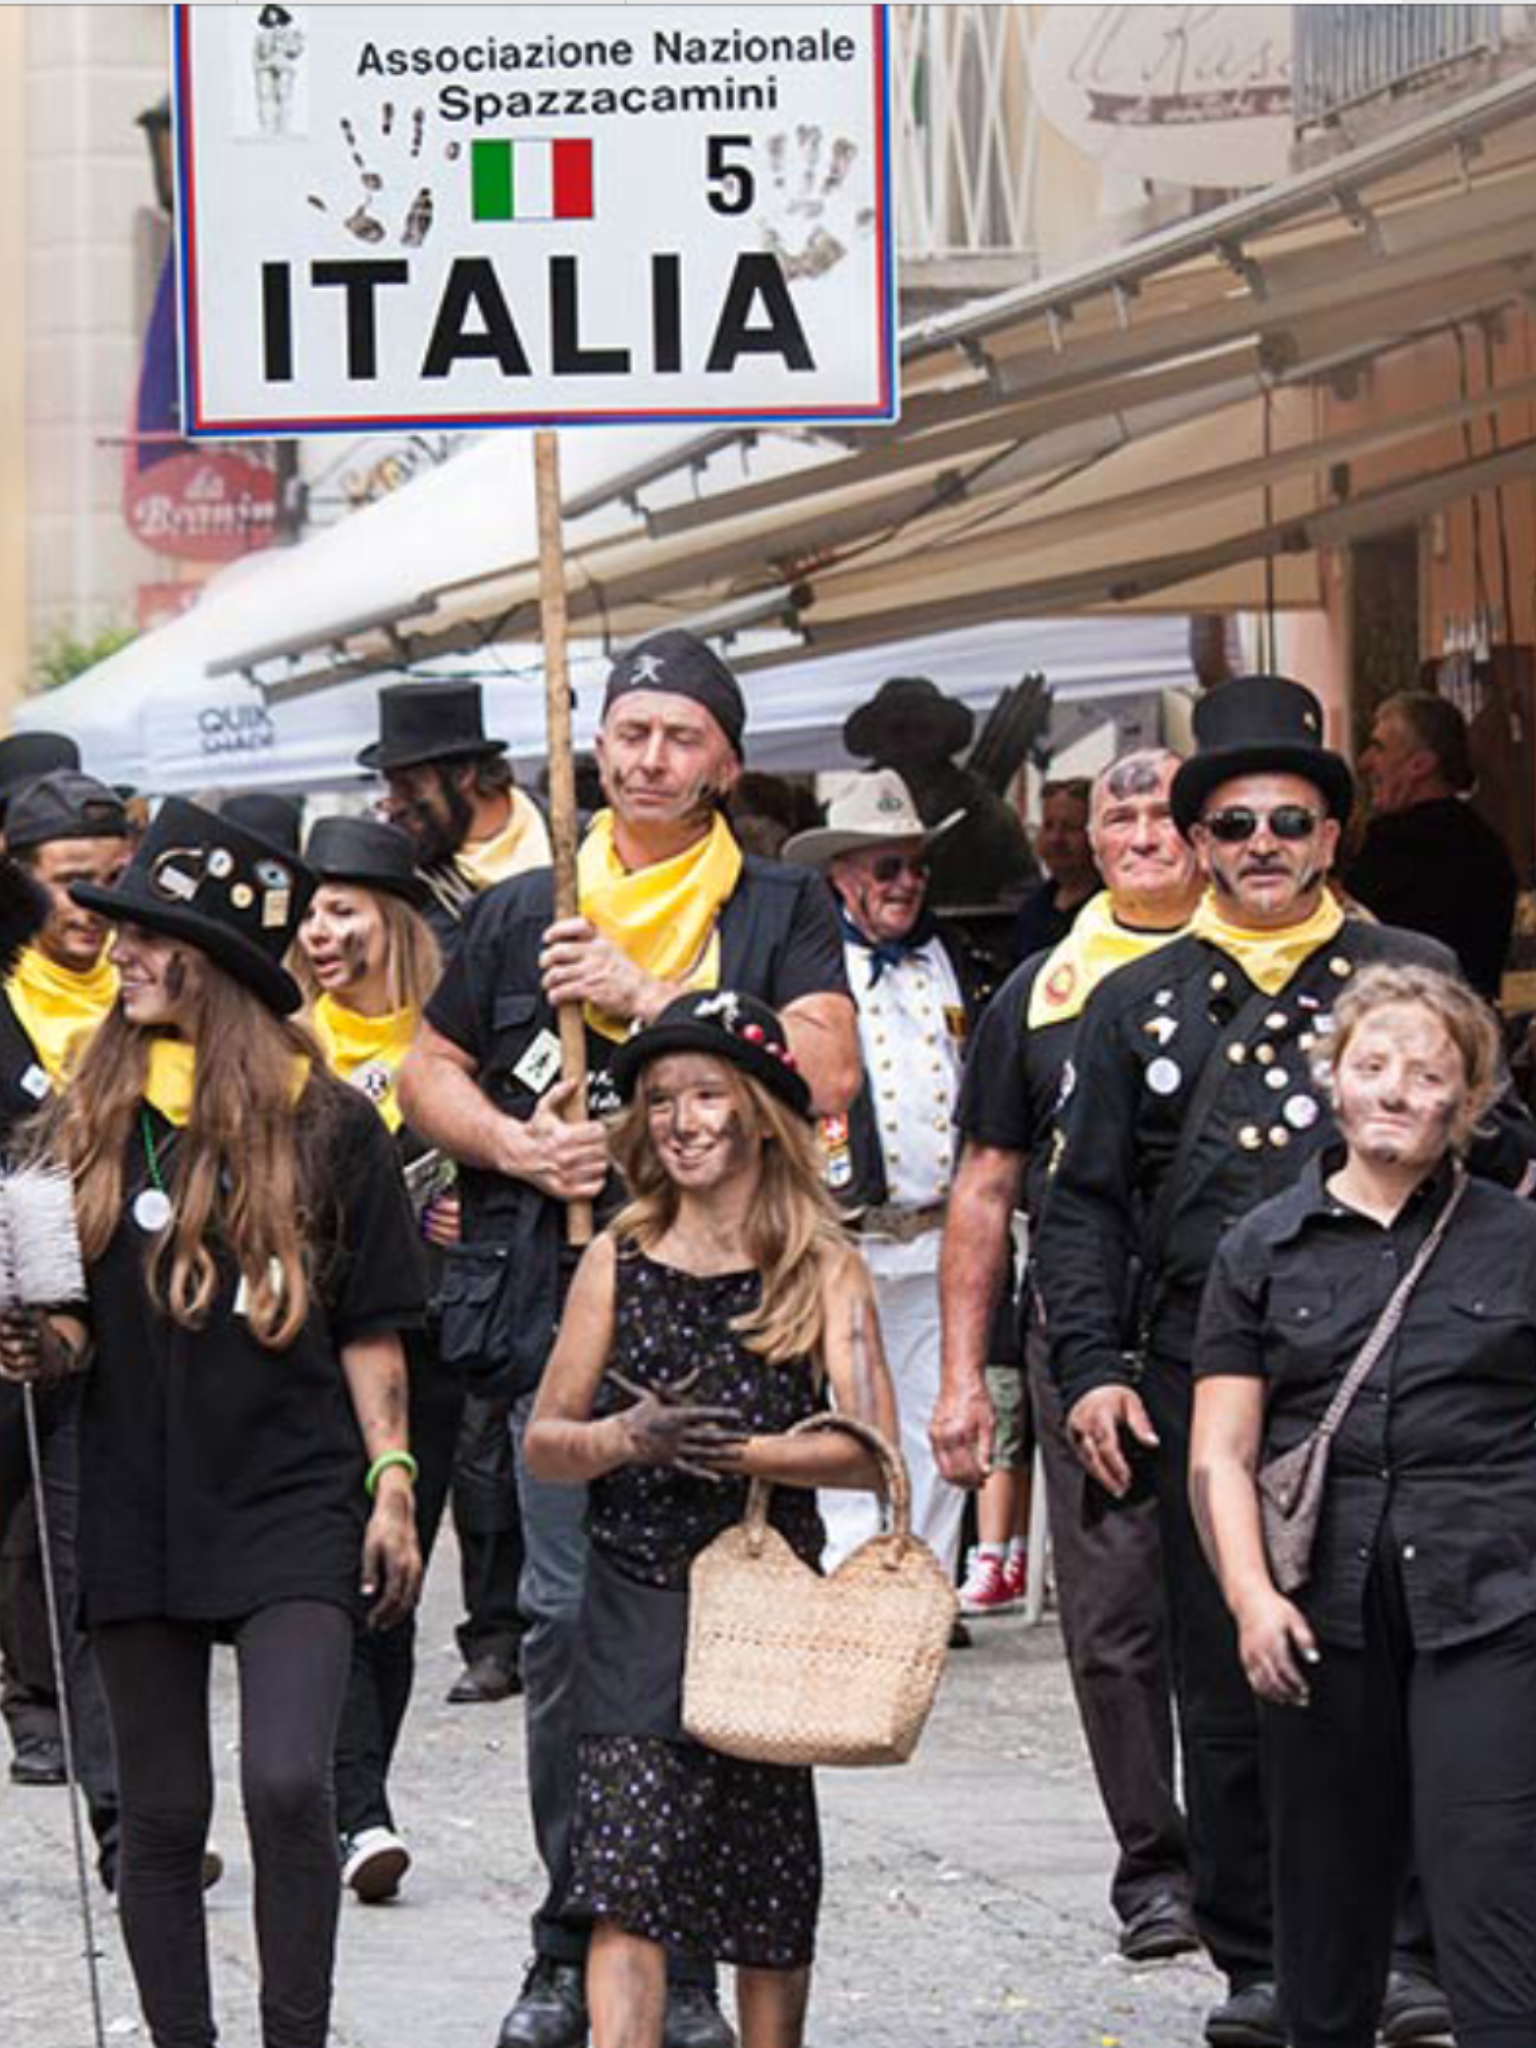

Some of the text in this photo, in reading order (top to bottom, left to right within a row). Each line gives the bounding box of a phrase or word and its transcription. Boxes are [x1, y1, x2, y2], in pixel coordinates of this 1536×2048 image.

[357, 28, 856, 76] Associazione Nazionale
[438, 75, 778, 126] Spazzacamini
[706, 134, 755, 216] 5
[261, 251, 816, 382] ITALIA
